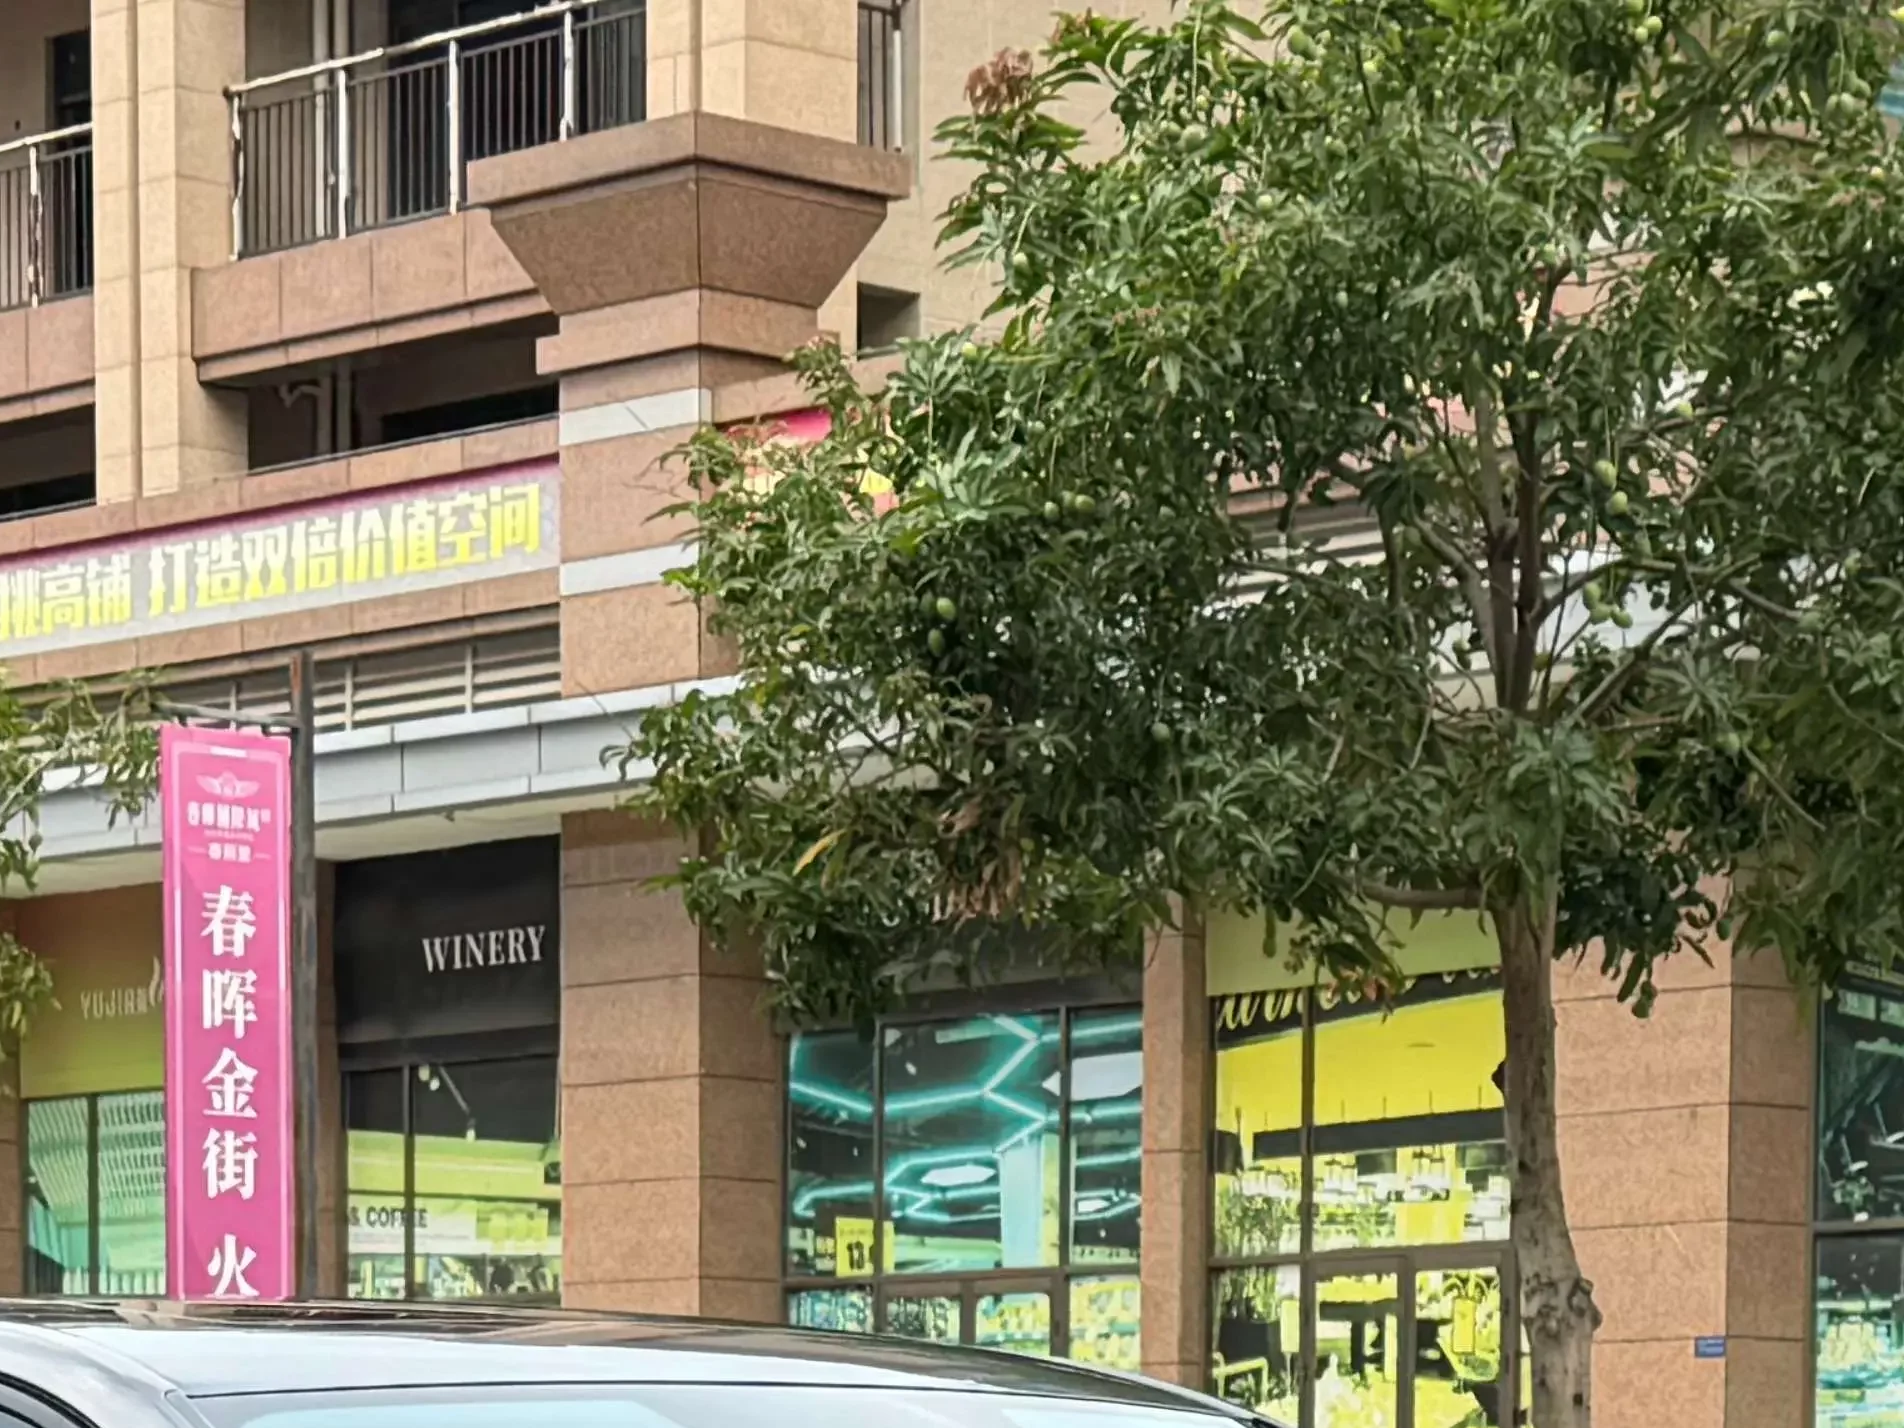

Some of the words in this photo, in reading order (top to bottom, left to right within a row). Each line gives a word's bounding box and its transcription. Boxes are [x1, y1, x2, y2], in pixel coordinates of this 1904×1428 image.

[149, 482, 540, 614] 打造双倍价值空间
[422, 924, 545, 973] WINERY
[200, 885, 259, 1200] 春晖金街
